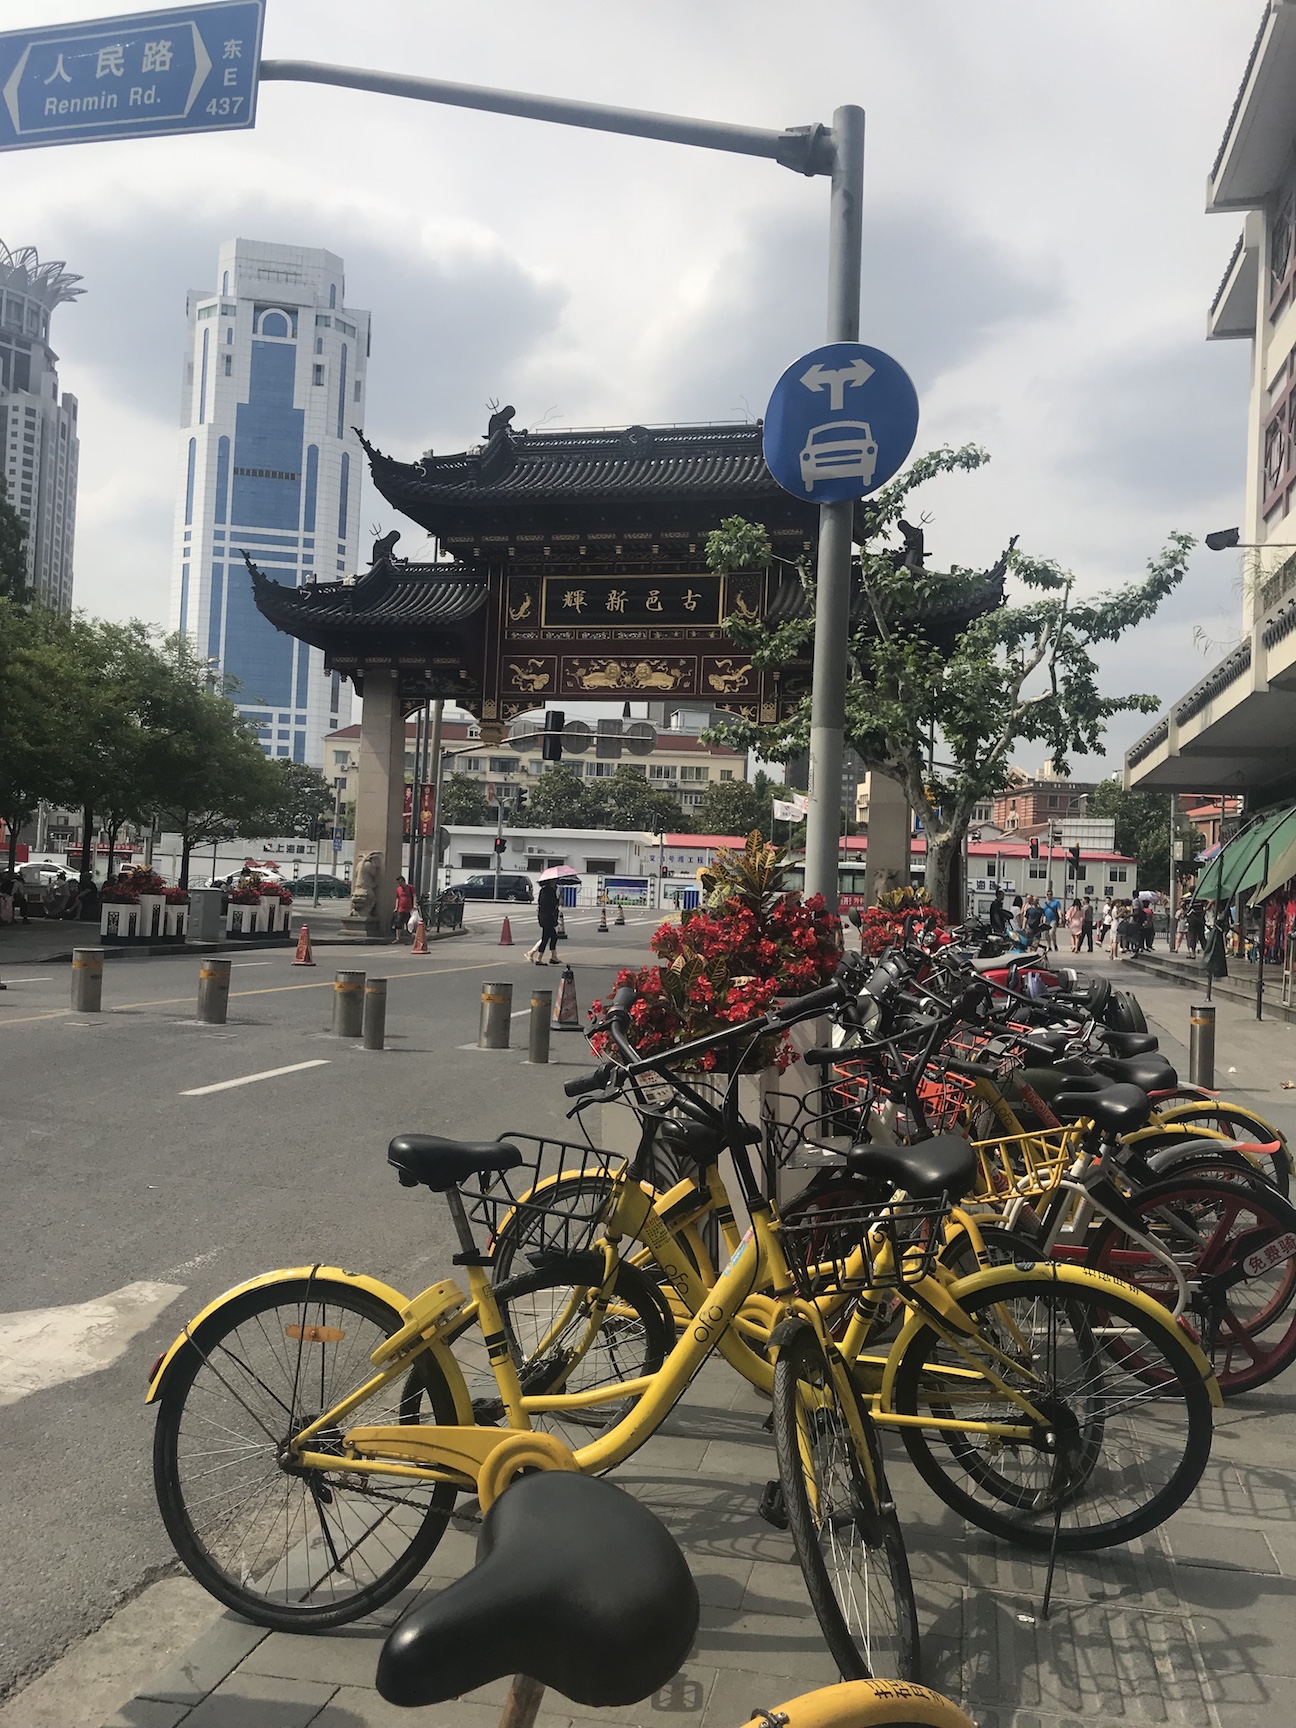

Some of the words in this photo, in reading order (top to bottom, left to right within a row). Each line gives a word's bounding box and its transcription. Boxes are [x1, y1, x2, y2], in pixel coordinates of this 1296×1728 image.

[44, 40, 174, 85] 人民路
[222, 39, 243, 60] 东
[223, 68, 238, 86] E
[44, 91, 118, 116] Renmin
[129, 85, 161, 107] Rd.
[206, 97, 244, 116] 437
[1000, 1107, 1013, 1127] ofo
[1027, 1090, 1056, 1125] mobike
[1248, 1235, 1296, 1274] 免费骑
[664, 1264, 689, 1295] ofo
[694, 1305, 724, 1342] ofo
